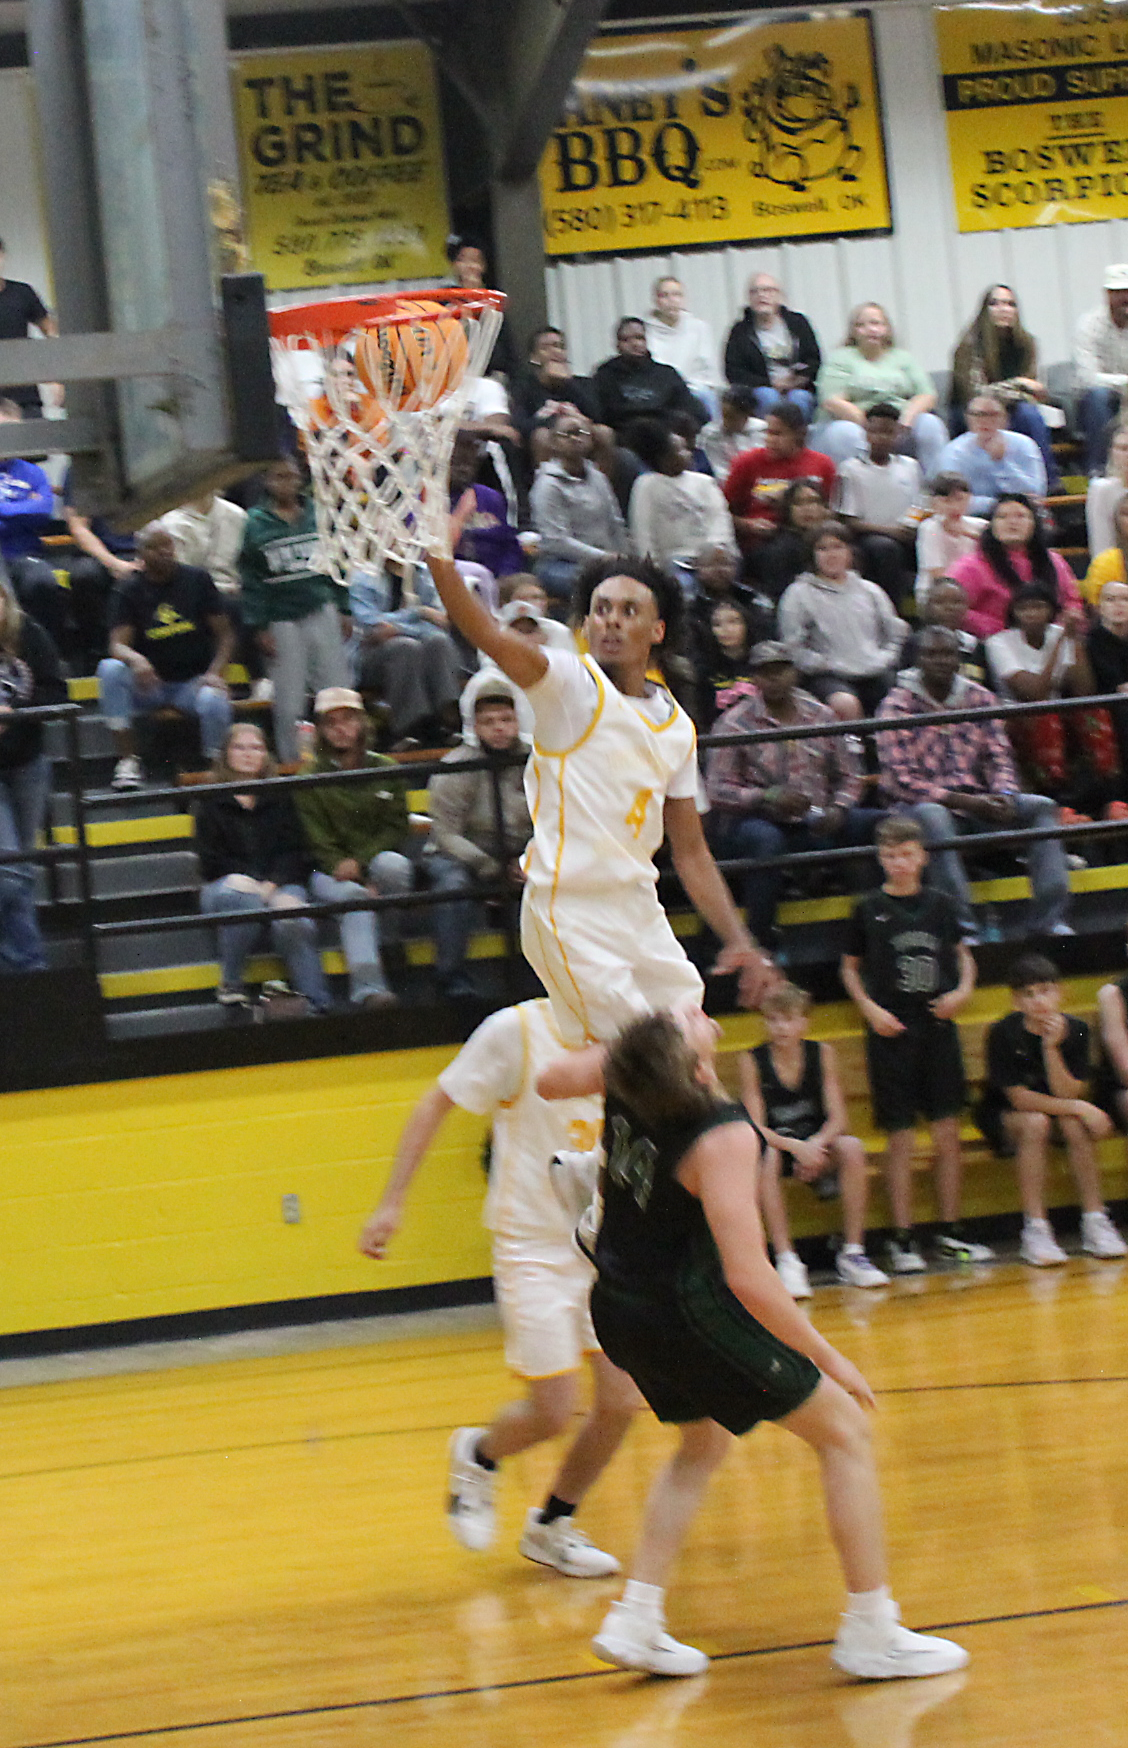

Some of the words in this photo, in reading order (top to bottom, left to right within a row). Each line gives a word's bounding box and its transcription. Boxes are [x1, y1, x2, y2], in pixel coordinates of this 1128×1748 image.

[970, 33, 1101, 65] MASONIC
[1109, 31, 1128, 54] L
[245, 71, 350, 119] THE
[957, 72, 1056, 103] PROUD
[252, 115, 426, 168] GRIND
[553, 121, 702, 193] BBQ
[981, 138, 1128, 175] BOSWE
